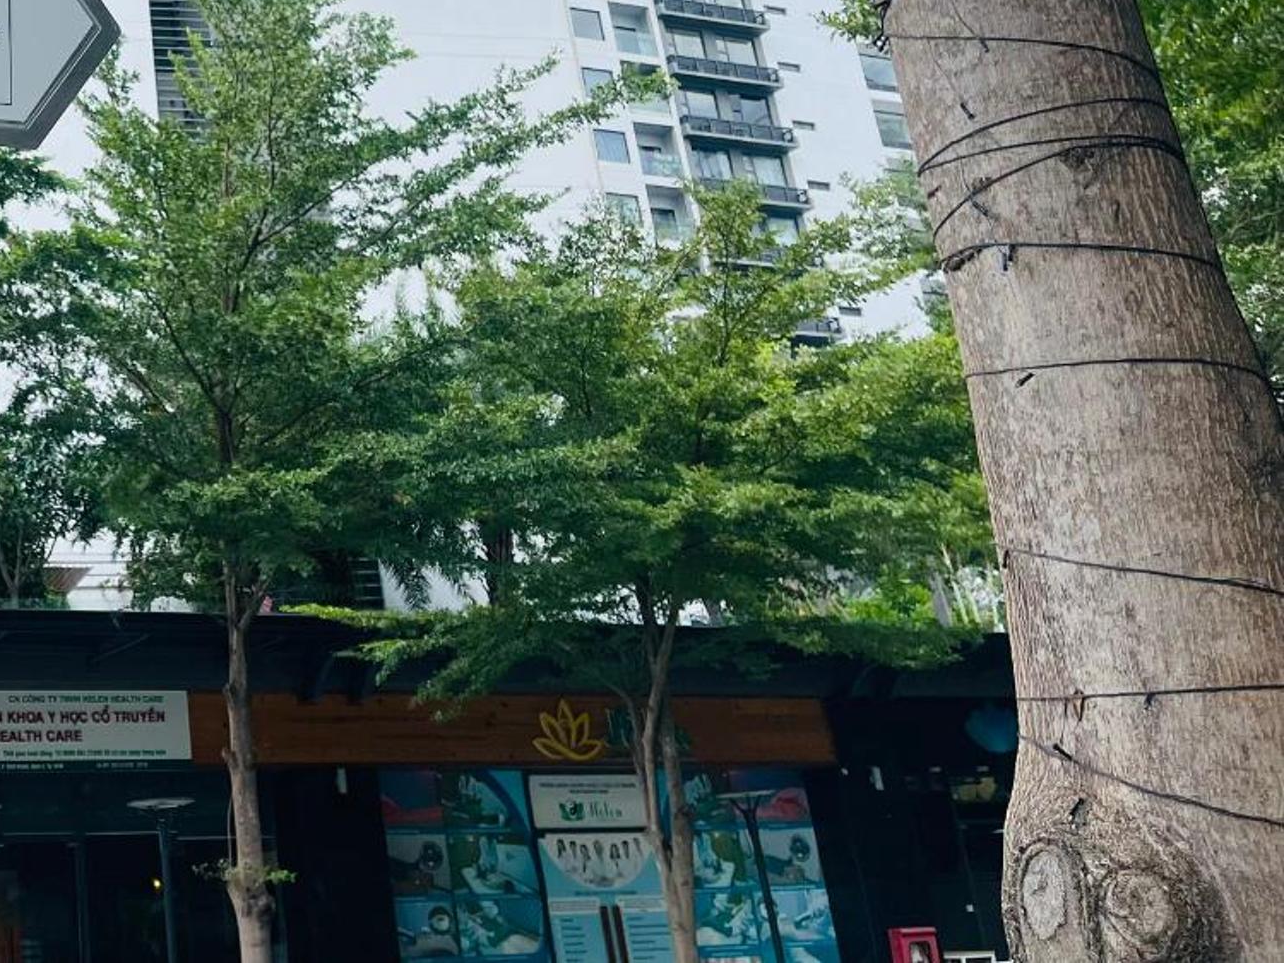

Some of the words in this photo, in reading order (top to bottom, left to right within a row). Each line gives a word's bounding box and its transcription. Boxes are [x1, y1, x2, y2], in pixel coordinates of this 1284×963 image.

[7, 711, 44, 724] KHOA
[48, 711, 57, 723] Y
[46, 729, 83, 742] CARE
